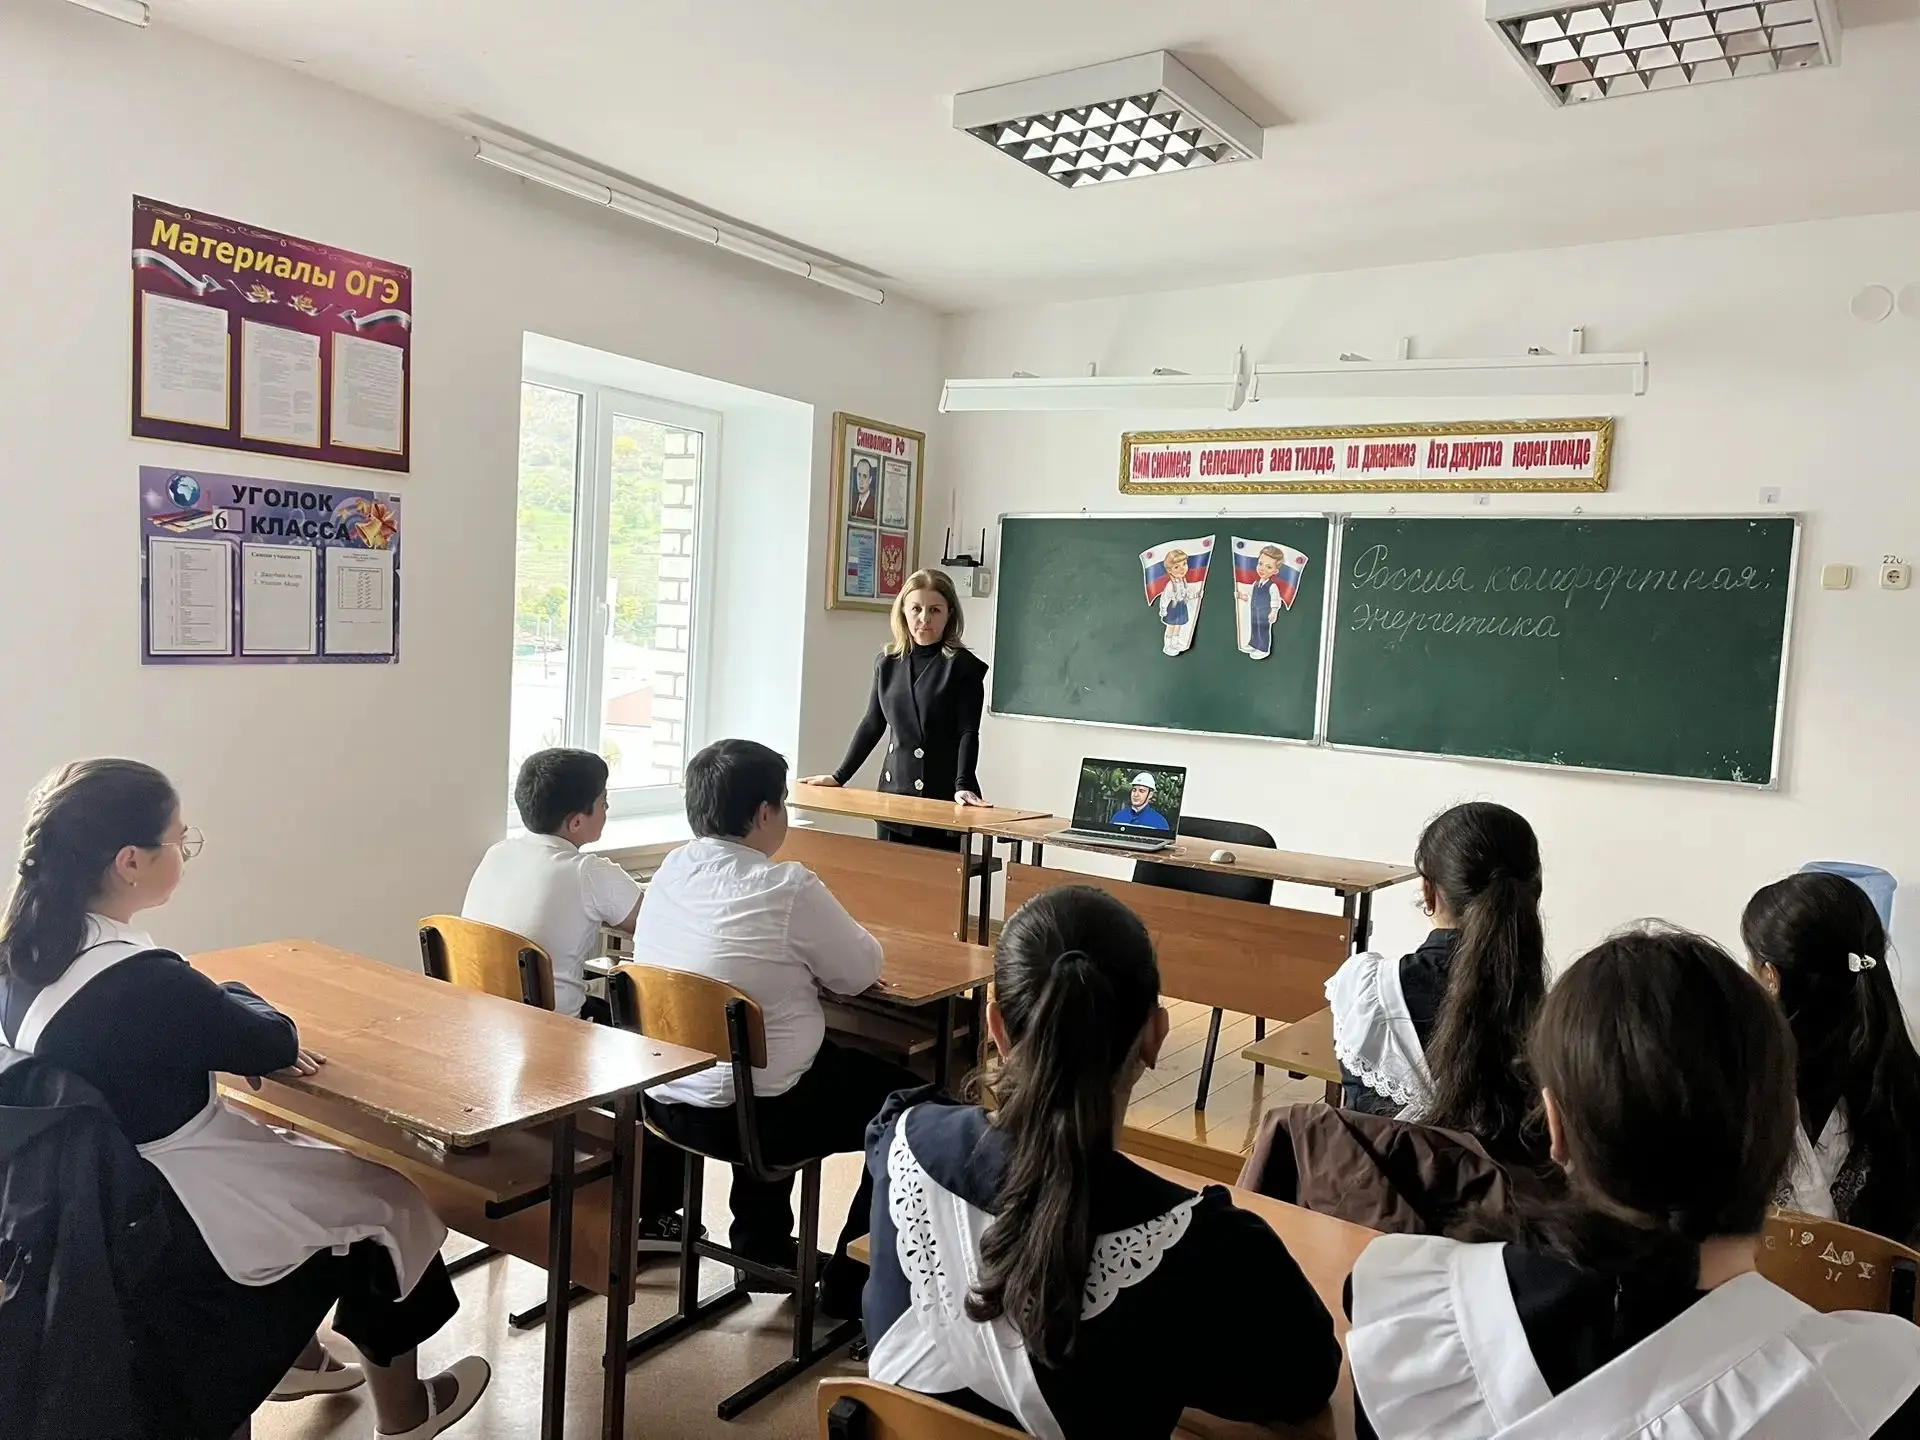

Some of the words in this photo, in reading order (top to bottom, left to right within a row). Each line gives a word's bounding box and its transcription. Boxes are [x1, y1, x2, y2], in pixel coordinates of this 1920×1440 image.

[151, 219, 335, 289] Материалы
[345, 271, 400, 304] ОГЭ
[856, 427, 892, 454] Символика
[895, 436, 905, 456] РФ
[1269, 447, 1293, 472] ана
[1295, 445, 1336, 475] тилде,
[1427, 439, 1448, 469] Ата
[1512, 441, 1547, 470] керек
[1549, 438, 1591, 470] кюнде
[232, 485, 333, 512] УГОЛОК
[215, 511, 227, 530] 6
[251, 516, 351, 541] КЛАССА
[1351, 544, 1474, 593] Россия
